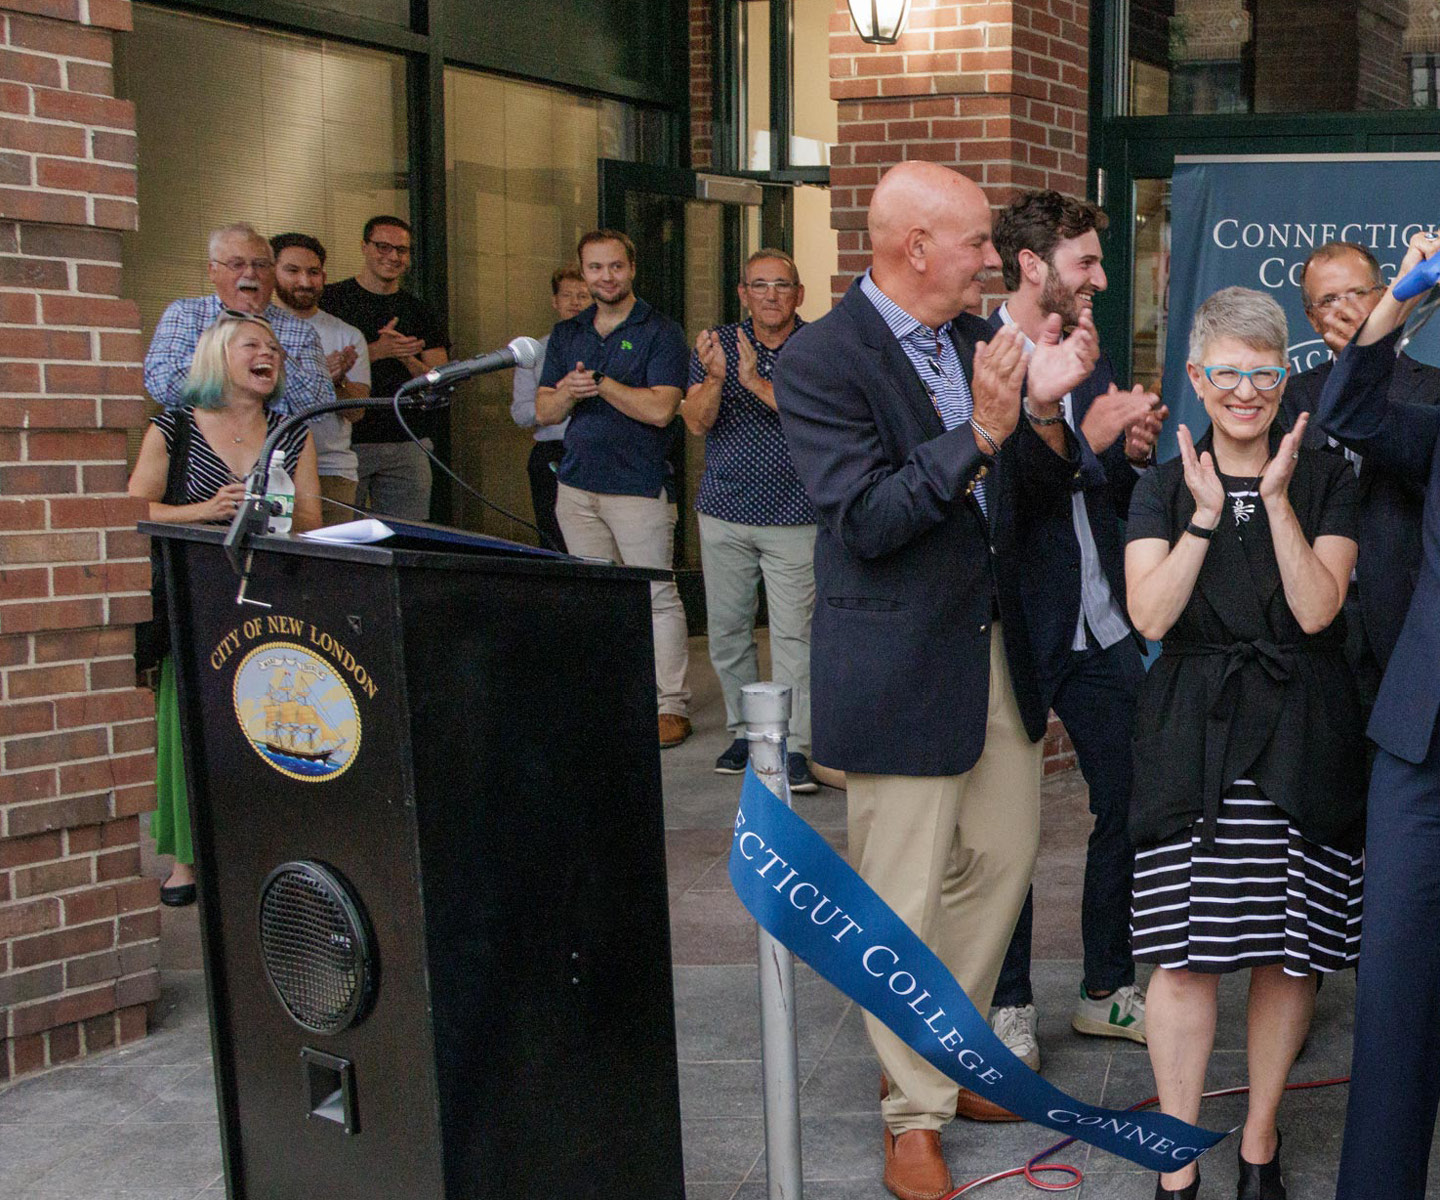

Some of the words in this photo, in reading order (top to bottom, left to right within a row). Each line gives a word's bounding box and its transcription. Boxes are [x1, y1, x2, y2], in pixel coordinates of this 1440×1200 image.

[210, 629, 241, 670] CITY
[243, 617, 263, 640] OF
[267, 615, 304, 637] NEW
[309, 624, 379, 700] LONDON
[862, 945, 1003, 1086] COLLEGE
